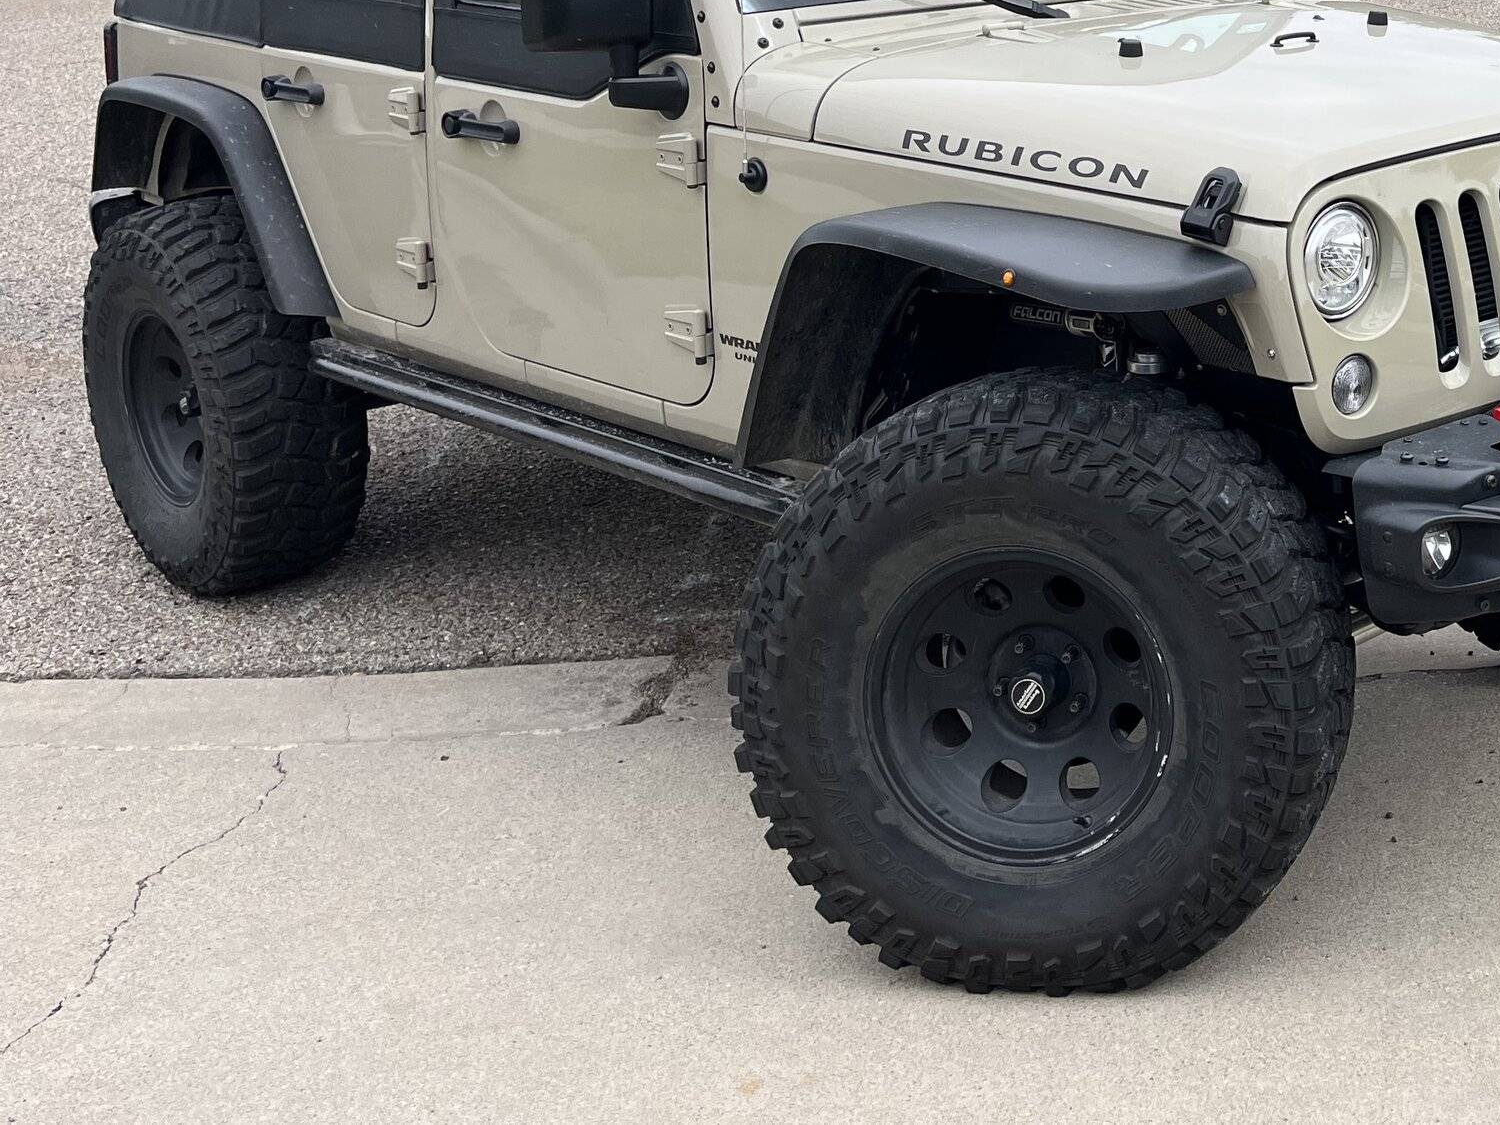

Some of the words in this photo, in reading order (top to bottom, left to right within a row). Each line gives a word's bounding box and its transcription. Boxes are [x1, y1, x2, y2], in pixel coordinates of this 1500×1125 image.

[901, 128, 1150, 190] RUBICON
[1012, 305, 1061, 324] FALCON
[719, 333, 761, 352] WRA
